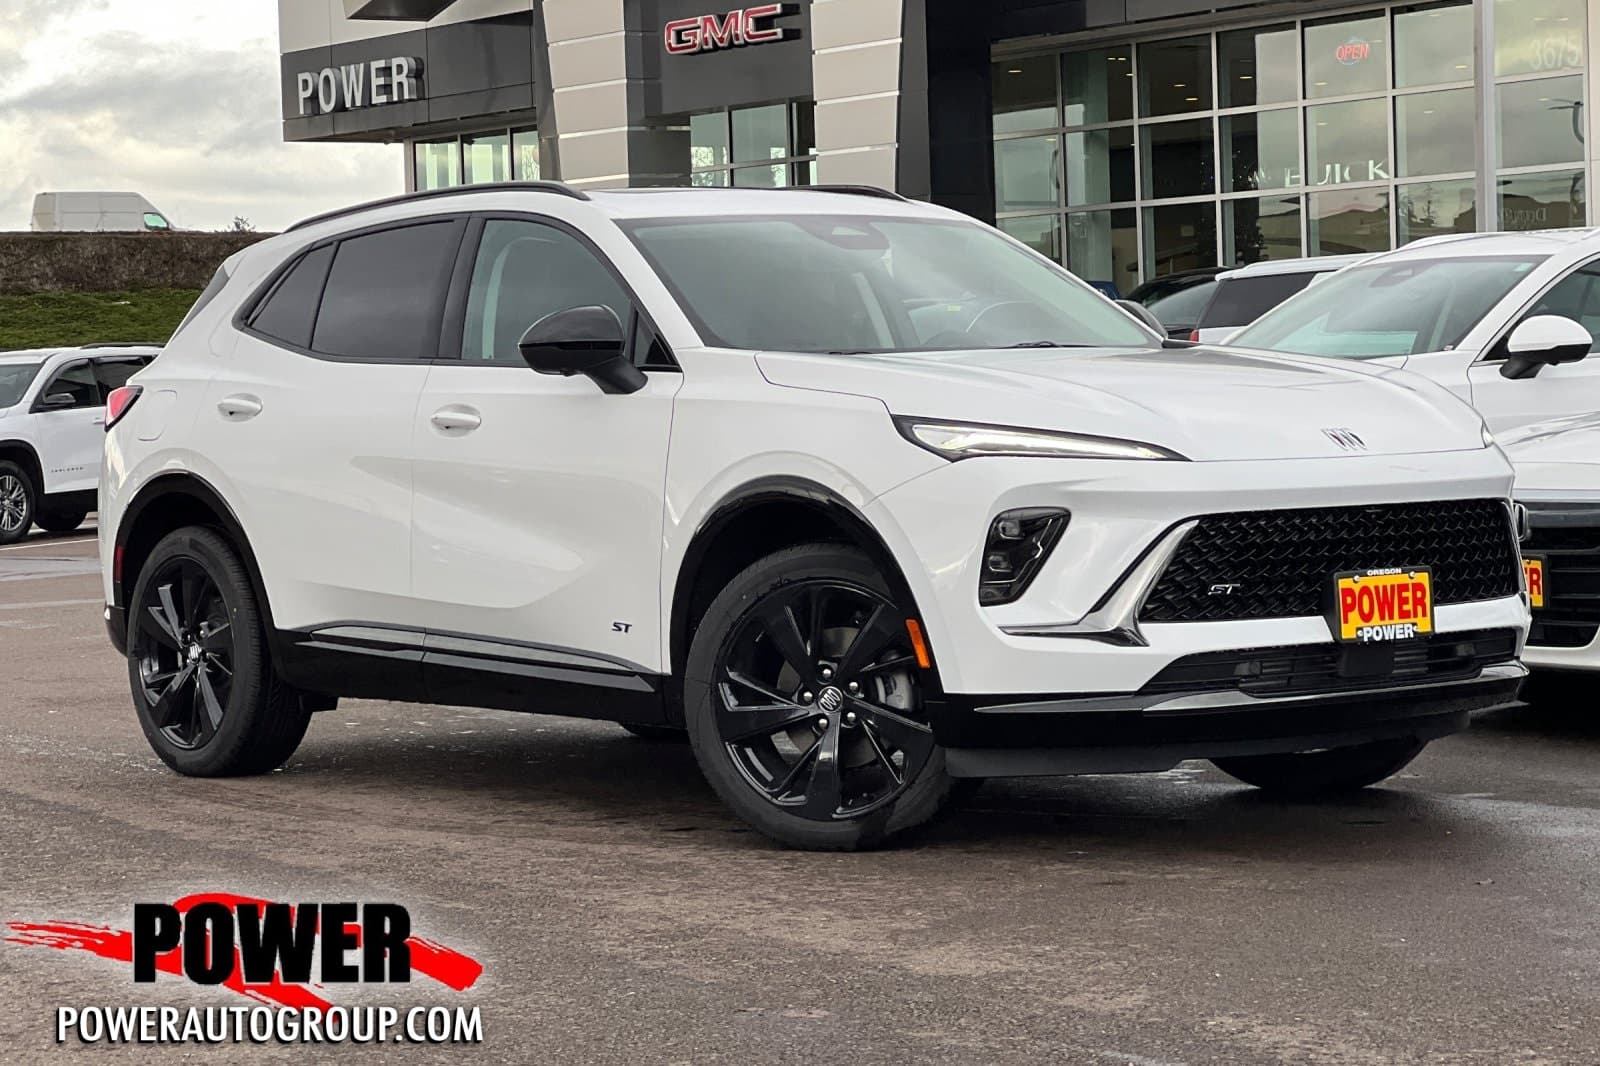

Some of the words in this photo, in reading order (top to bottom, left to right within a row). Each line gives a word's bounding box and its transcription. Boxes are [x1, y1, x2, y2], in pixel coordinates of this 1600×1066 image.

[664, 3, 783, 54] GMC
[1336, 43, 1369, 60] OPEN
[297, 56, 414, 115] POWER
[1366, 568, 1402, 576] OREGON
[1207, 583, 1240, 595] ST
[1341, 582, 1427, 624] POWER
[612, 621, 633, 633] ST
[1363, 623, 1414, 642] POWER
